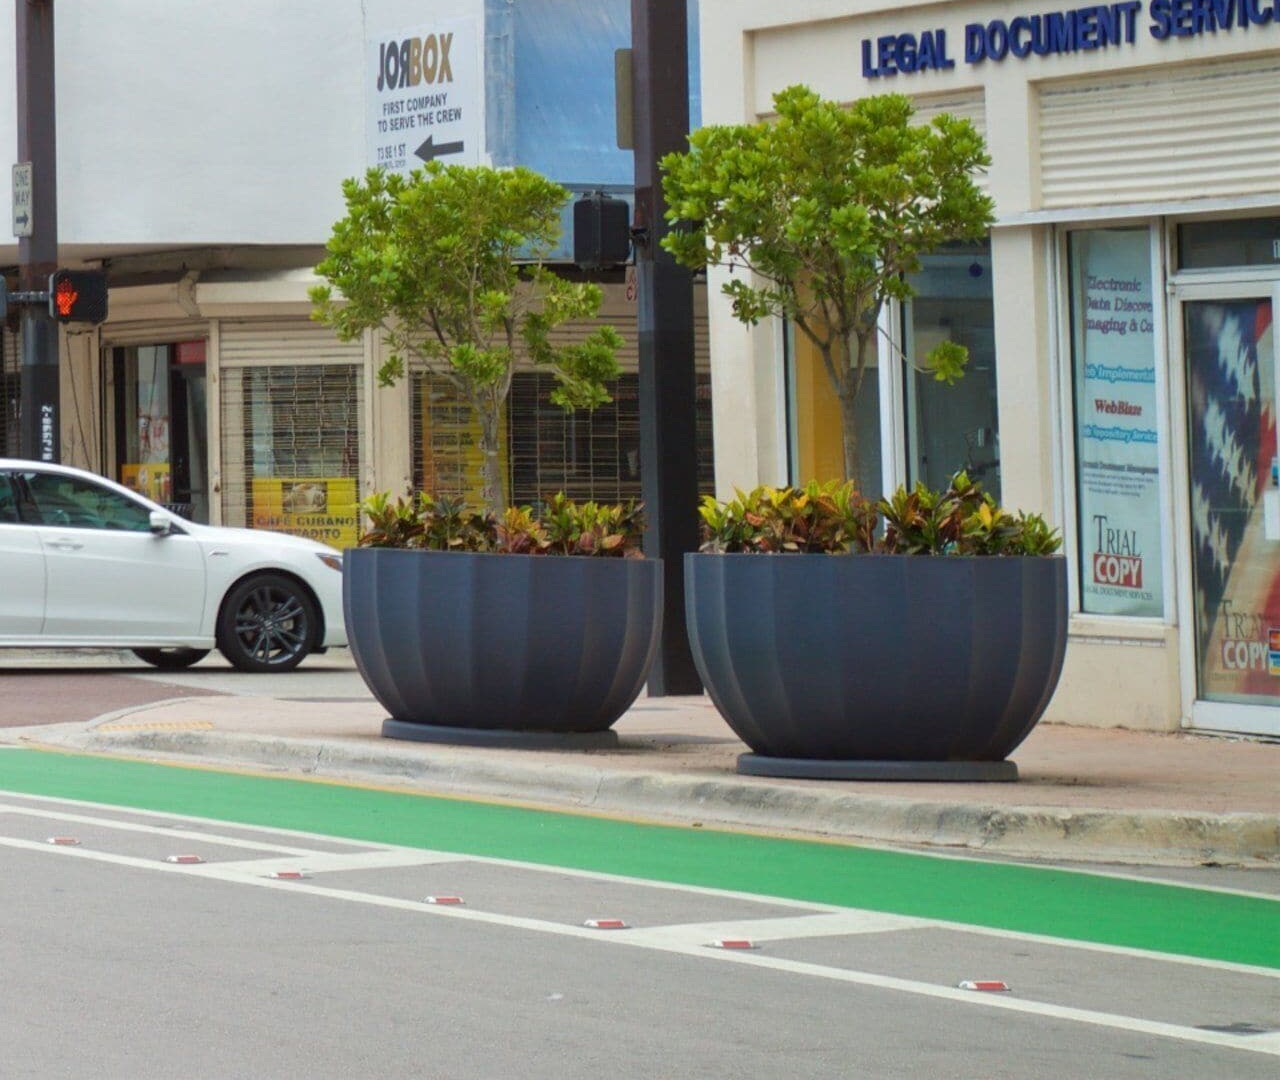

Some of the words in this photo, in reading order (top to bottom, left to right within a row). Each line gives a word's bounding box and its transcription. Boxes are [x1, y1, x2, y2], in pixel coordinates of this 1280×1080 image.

[861, 22, 955, 79] LEGAL
[964, 0, 1141, 66] DOCUMENT
[383, 101, 405, 116] FIRST
[406, 93, 447, 111] COMPANY
[378, 120, 387, 133] TO
[390, 115, 415, 131] SERVE
[417, 111, 434, 125] THE
[436, 107, 462, 123] CREW
[385, 145, 393, 159] SE
[398, 143, 406, 157] ST
[16, 169, 29, 186] ONE
[16, 191, 30, 206] WAY
[1093, 514, 1142, 557] TRIAL
[1095, 556, 1140, 586] COPY
